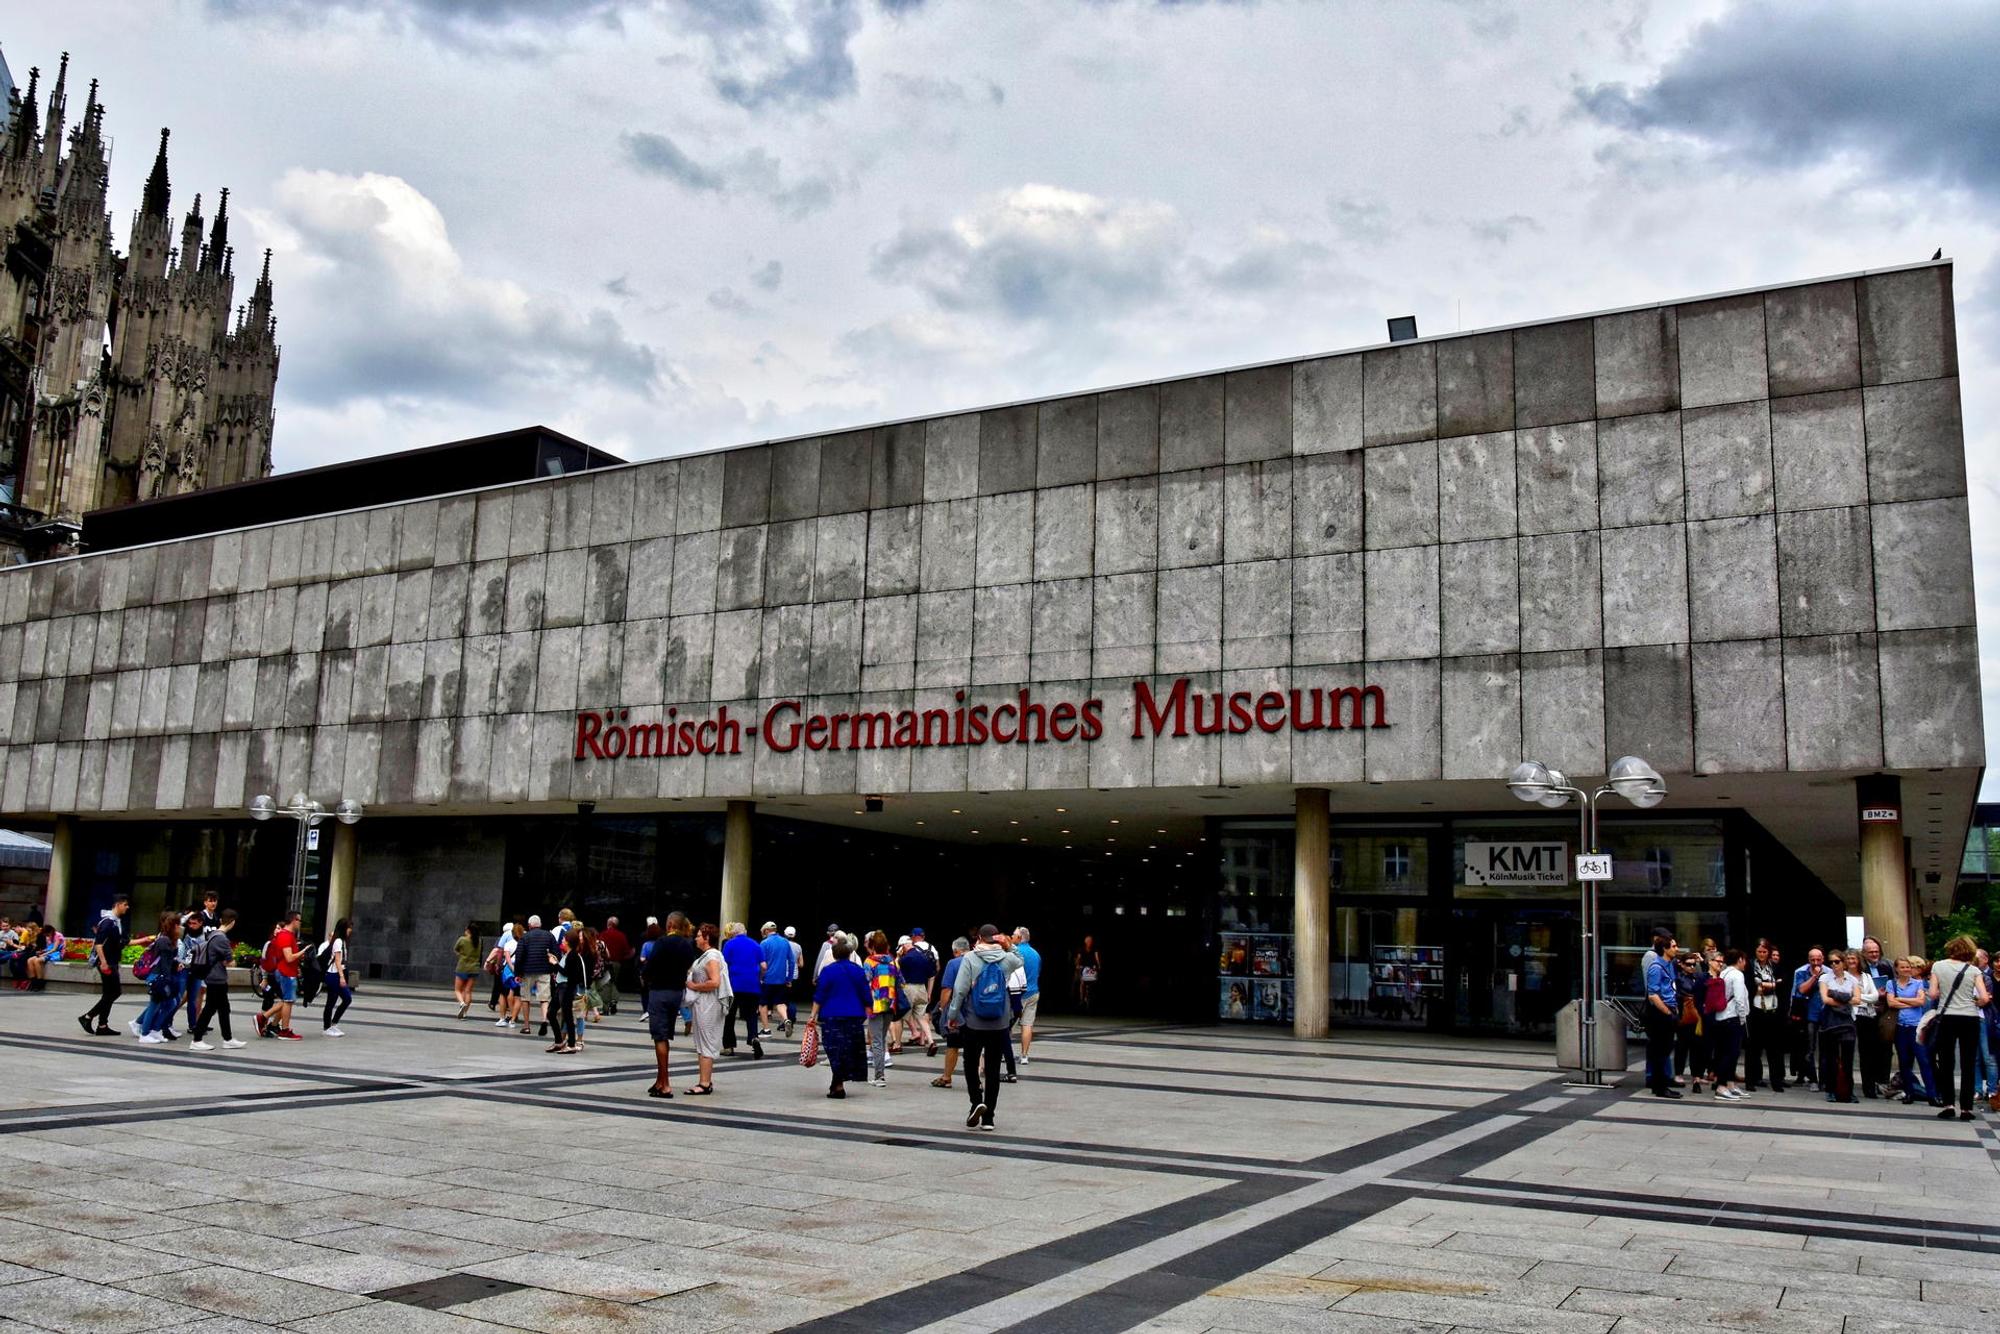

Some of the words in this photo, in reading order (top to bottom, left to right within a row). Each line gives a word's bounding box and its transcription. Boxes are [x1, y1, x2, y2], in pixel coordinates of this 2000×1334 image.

[574, 688, 1103, 760] Römisch-Germanisches
[1131, 677, 1391, 739] Museum
[1489, 846, 1562, 871] KMT
[1489, 872, 1536, 881] KölnMusik
[1537, 872, 1564, 881] Ticket
